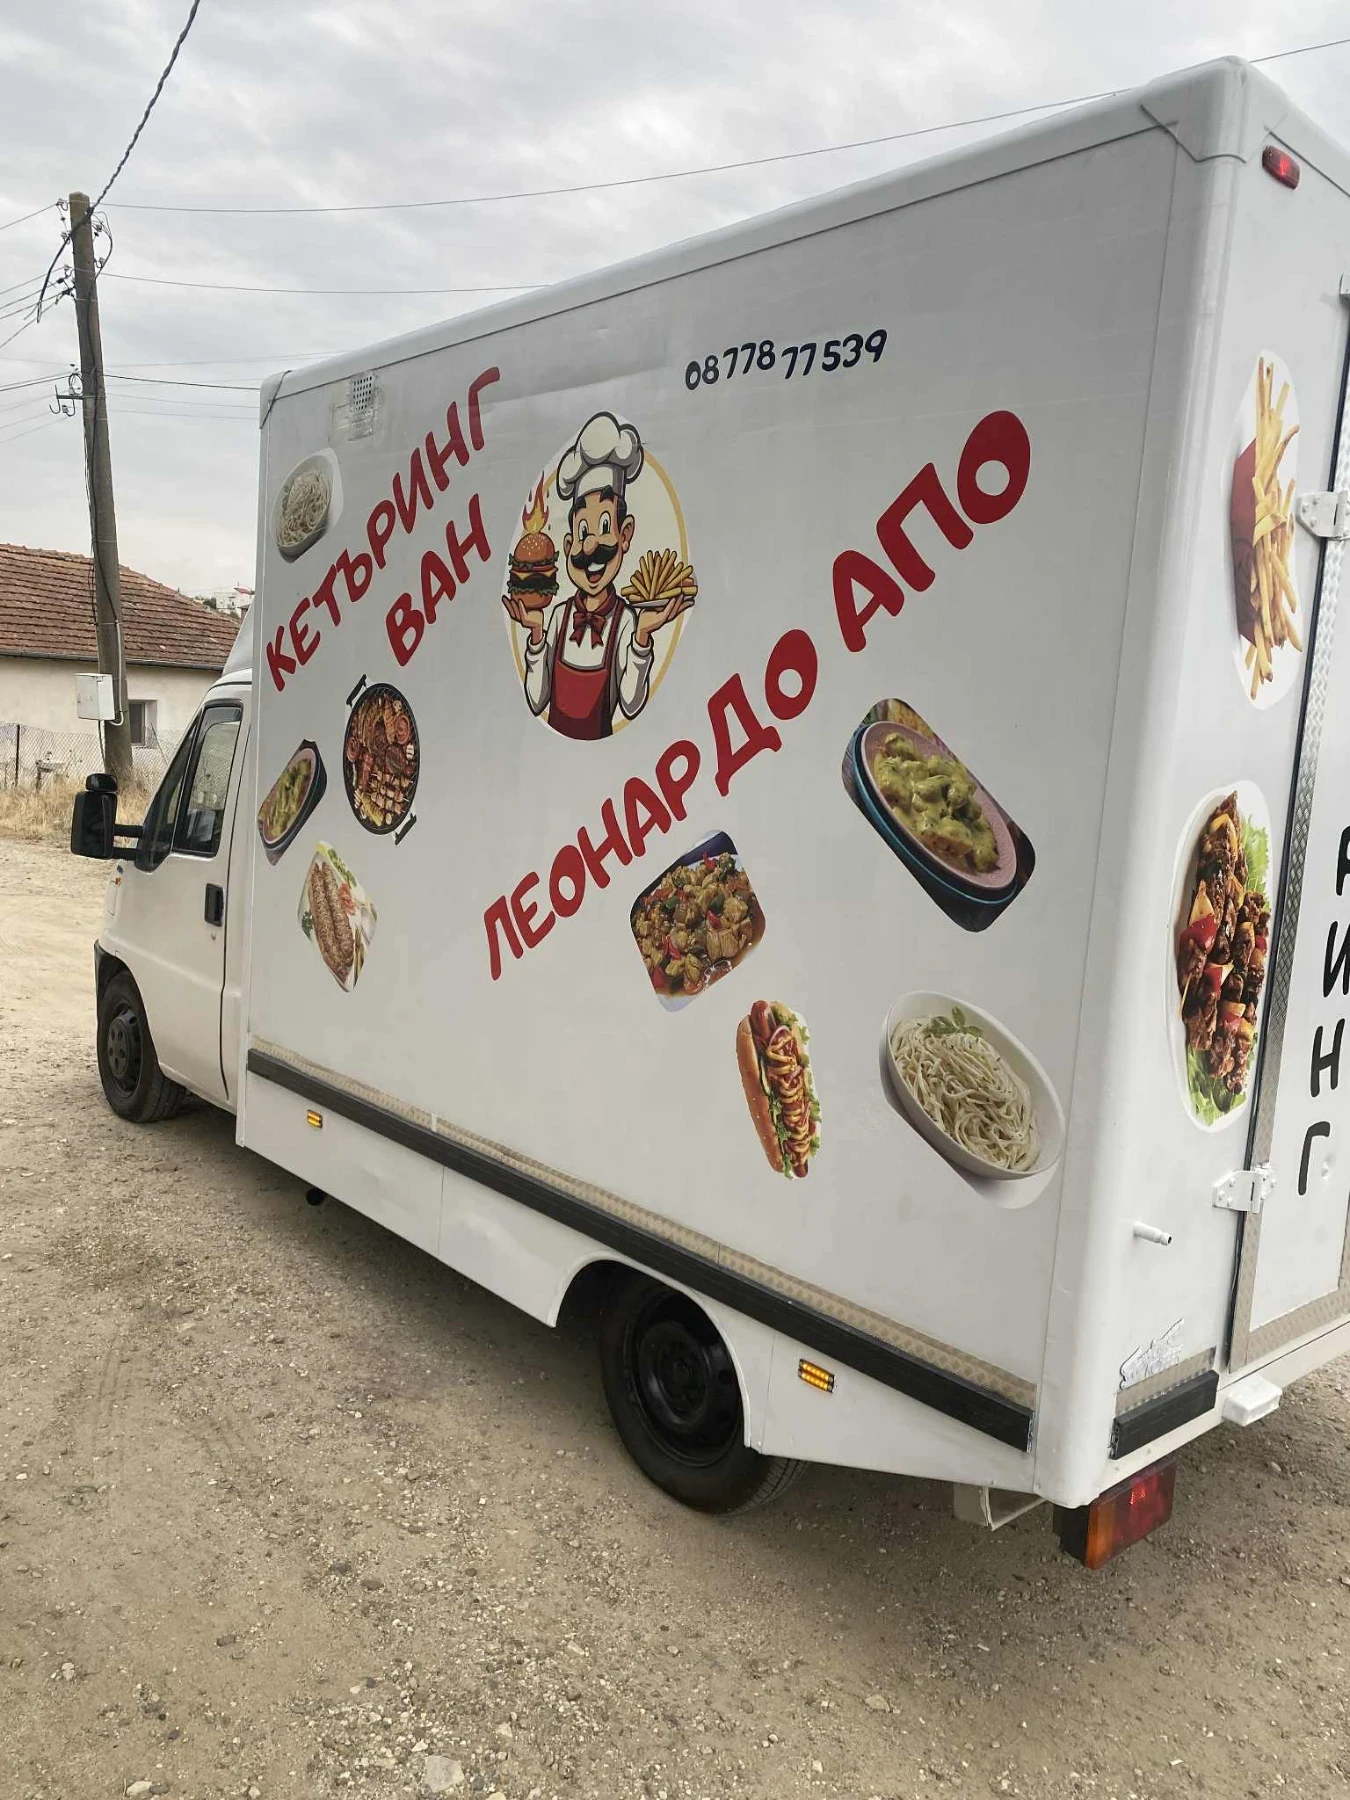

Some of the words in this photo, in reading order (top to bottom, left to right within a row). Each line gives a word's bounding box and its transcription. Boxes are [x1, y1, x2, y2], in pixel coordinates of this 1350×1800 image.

[266, 366, 500, 691] КЕТЪРИНГ
[386, 493, 492, 667] ВАН
[482, 629, 819, 981] ЛЕОНАРДО
[832, 410, 1031, 653] АПО
